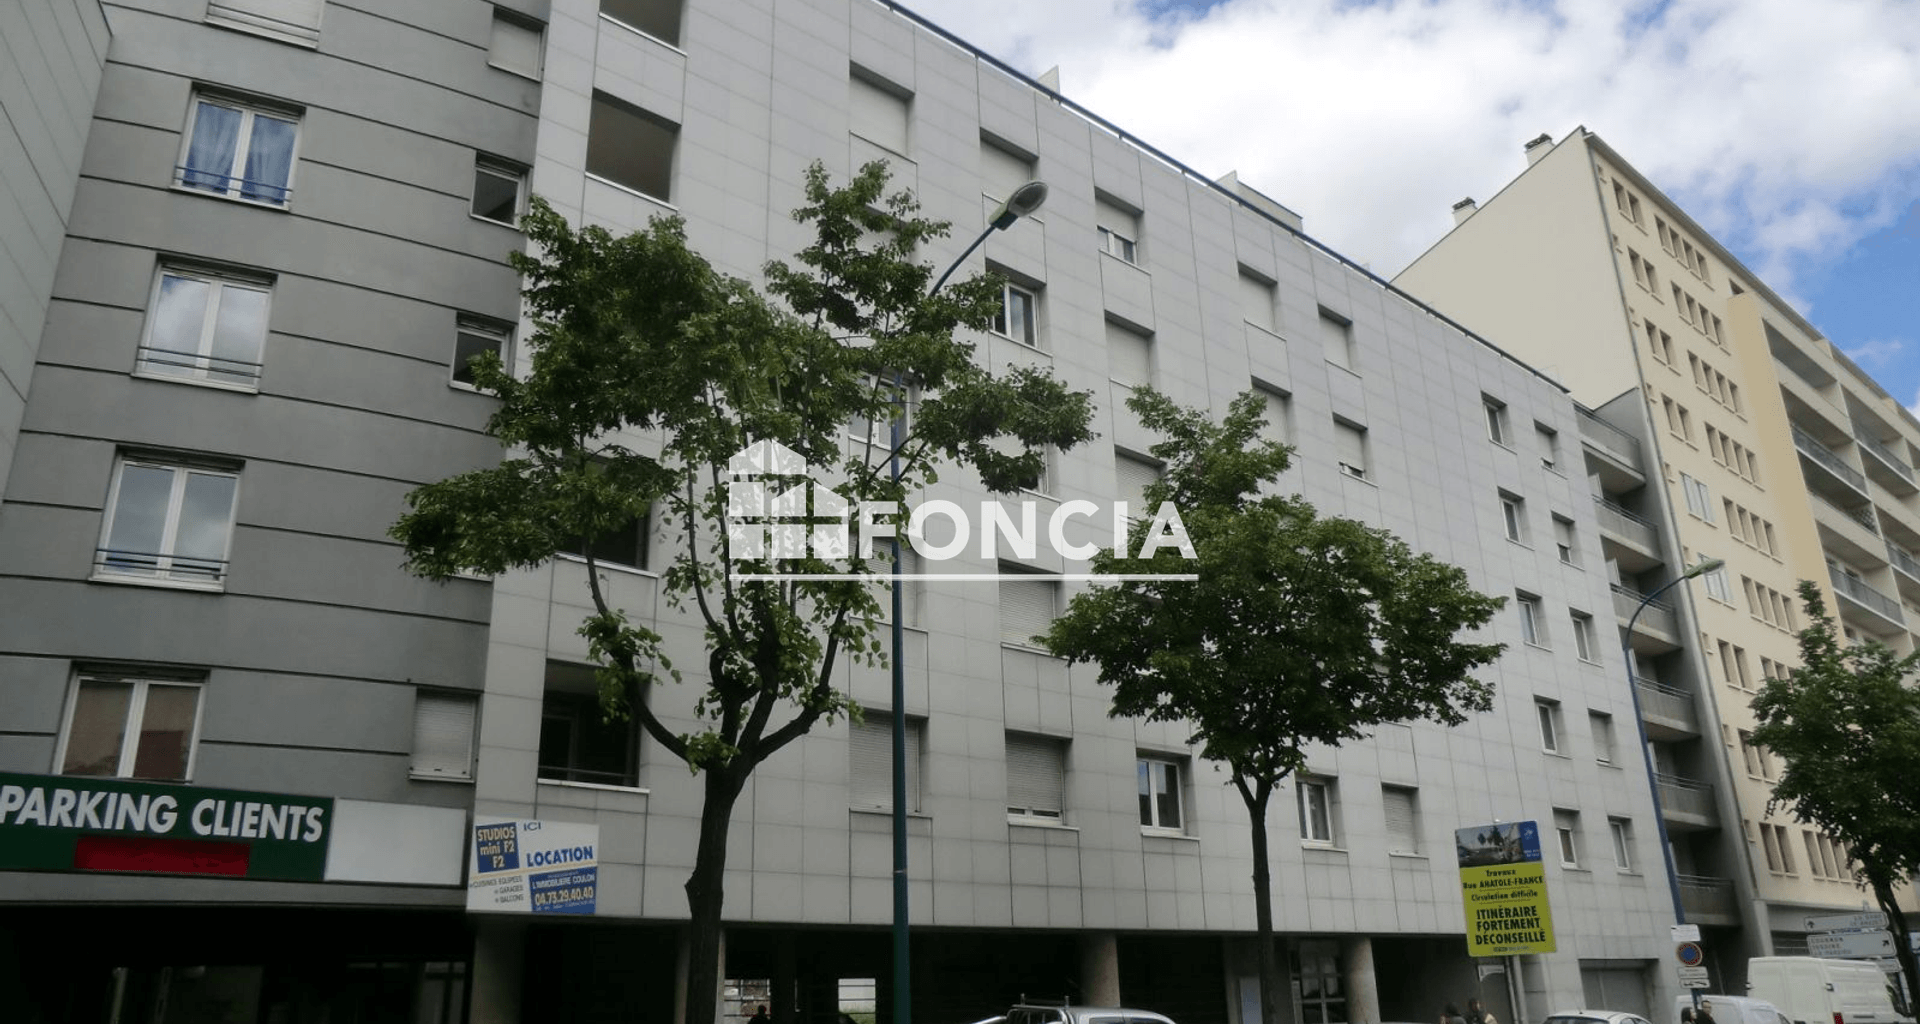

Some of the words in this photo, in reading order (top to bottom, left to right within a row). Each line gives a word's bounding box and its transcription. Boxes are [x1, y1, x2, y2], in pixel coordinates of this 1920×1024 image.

[0, 785, 178, 834] PARKING
[191, 798, 324, 843] CLIENTS
[523, 821, 542, 831] ICI
[477, 826, 515, 842] STUDIOS
[479, 841, 501, 855] mini
[503, 840, 515, 853] F2
[492, 856, 505, 868] F2
[526, 845, 594, 867] LOCATION
[1479, 876, 1544, 888] ANATOLE-FRANCE
[534, 886, 594, 906] 04.73.29.40.40
[1476, 905, 1538, 920] ITINÉRAIRE
[1476, 917, 1541, 932] FORTEMENT
[1475, 929, 1546, 946] DÉCONSEILLÉ
